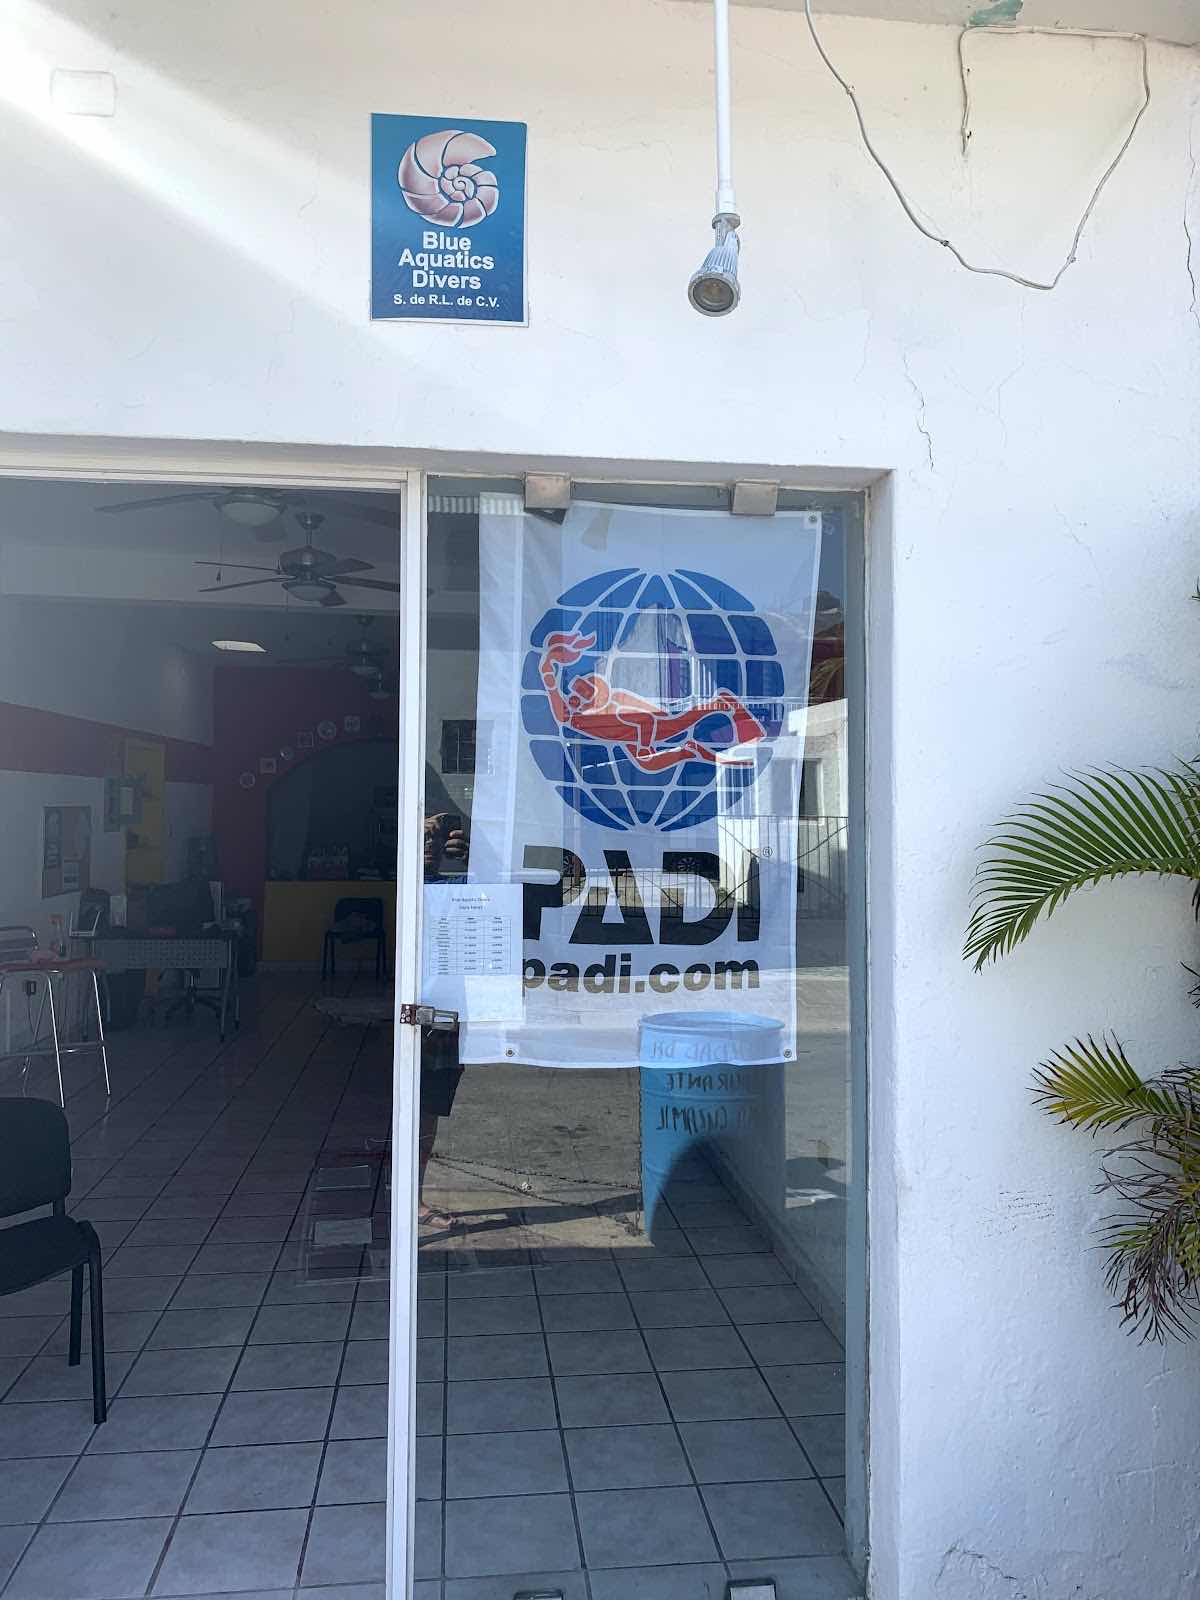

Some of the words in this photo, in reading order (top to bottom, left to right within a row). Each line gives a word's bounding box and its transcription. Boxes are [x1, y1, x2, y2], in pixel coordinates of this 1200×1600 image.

[422, 230, 472, 251] Blue
[398, 247, 495, 271] Aquatics
[412, 269, 482, 290] Divers
[393, 293, 407, 305] S.
[409, 293, 426, 305] de
[428, 294, 454, 305] R.L.
[456, 295, 473, 306] de
[475, 295, 500, 308] C.V.
[522, 844, 761, 945] PADI
[522, 952, 760, 997] padi.com
